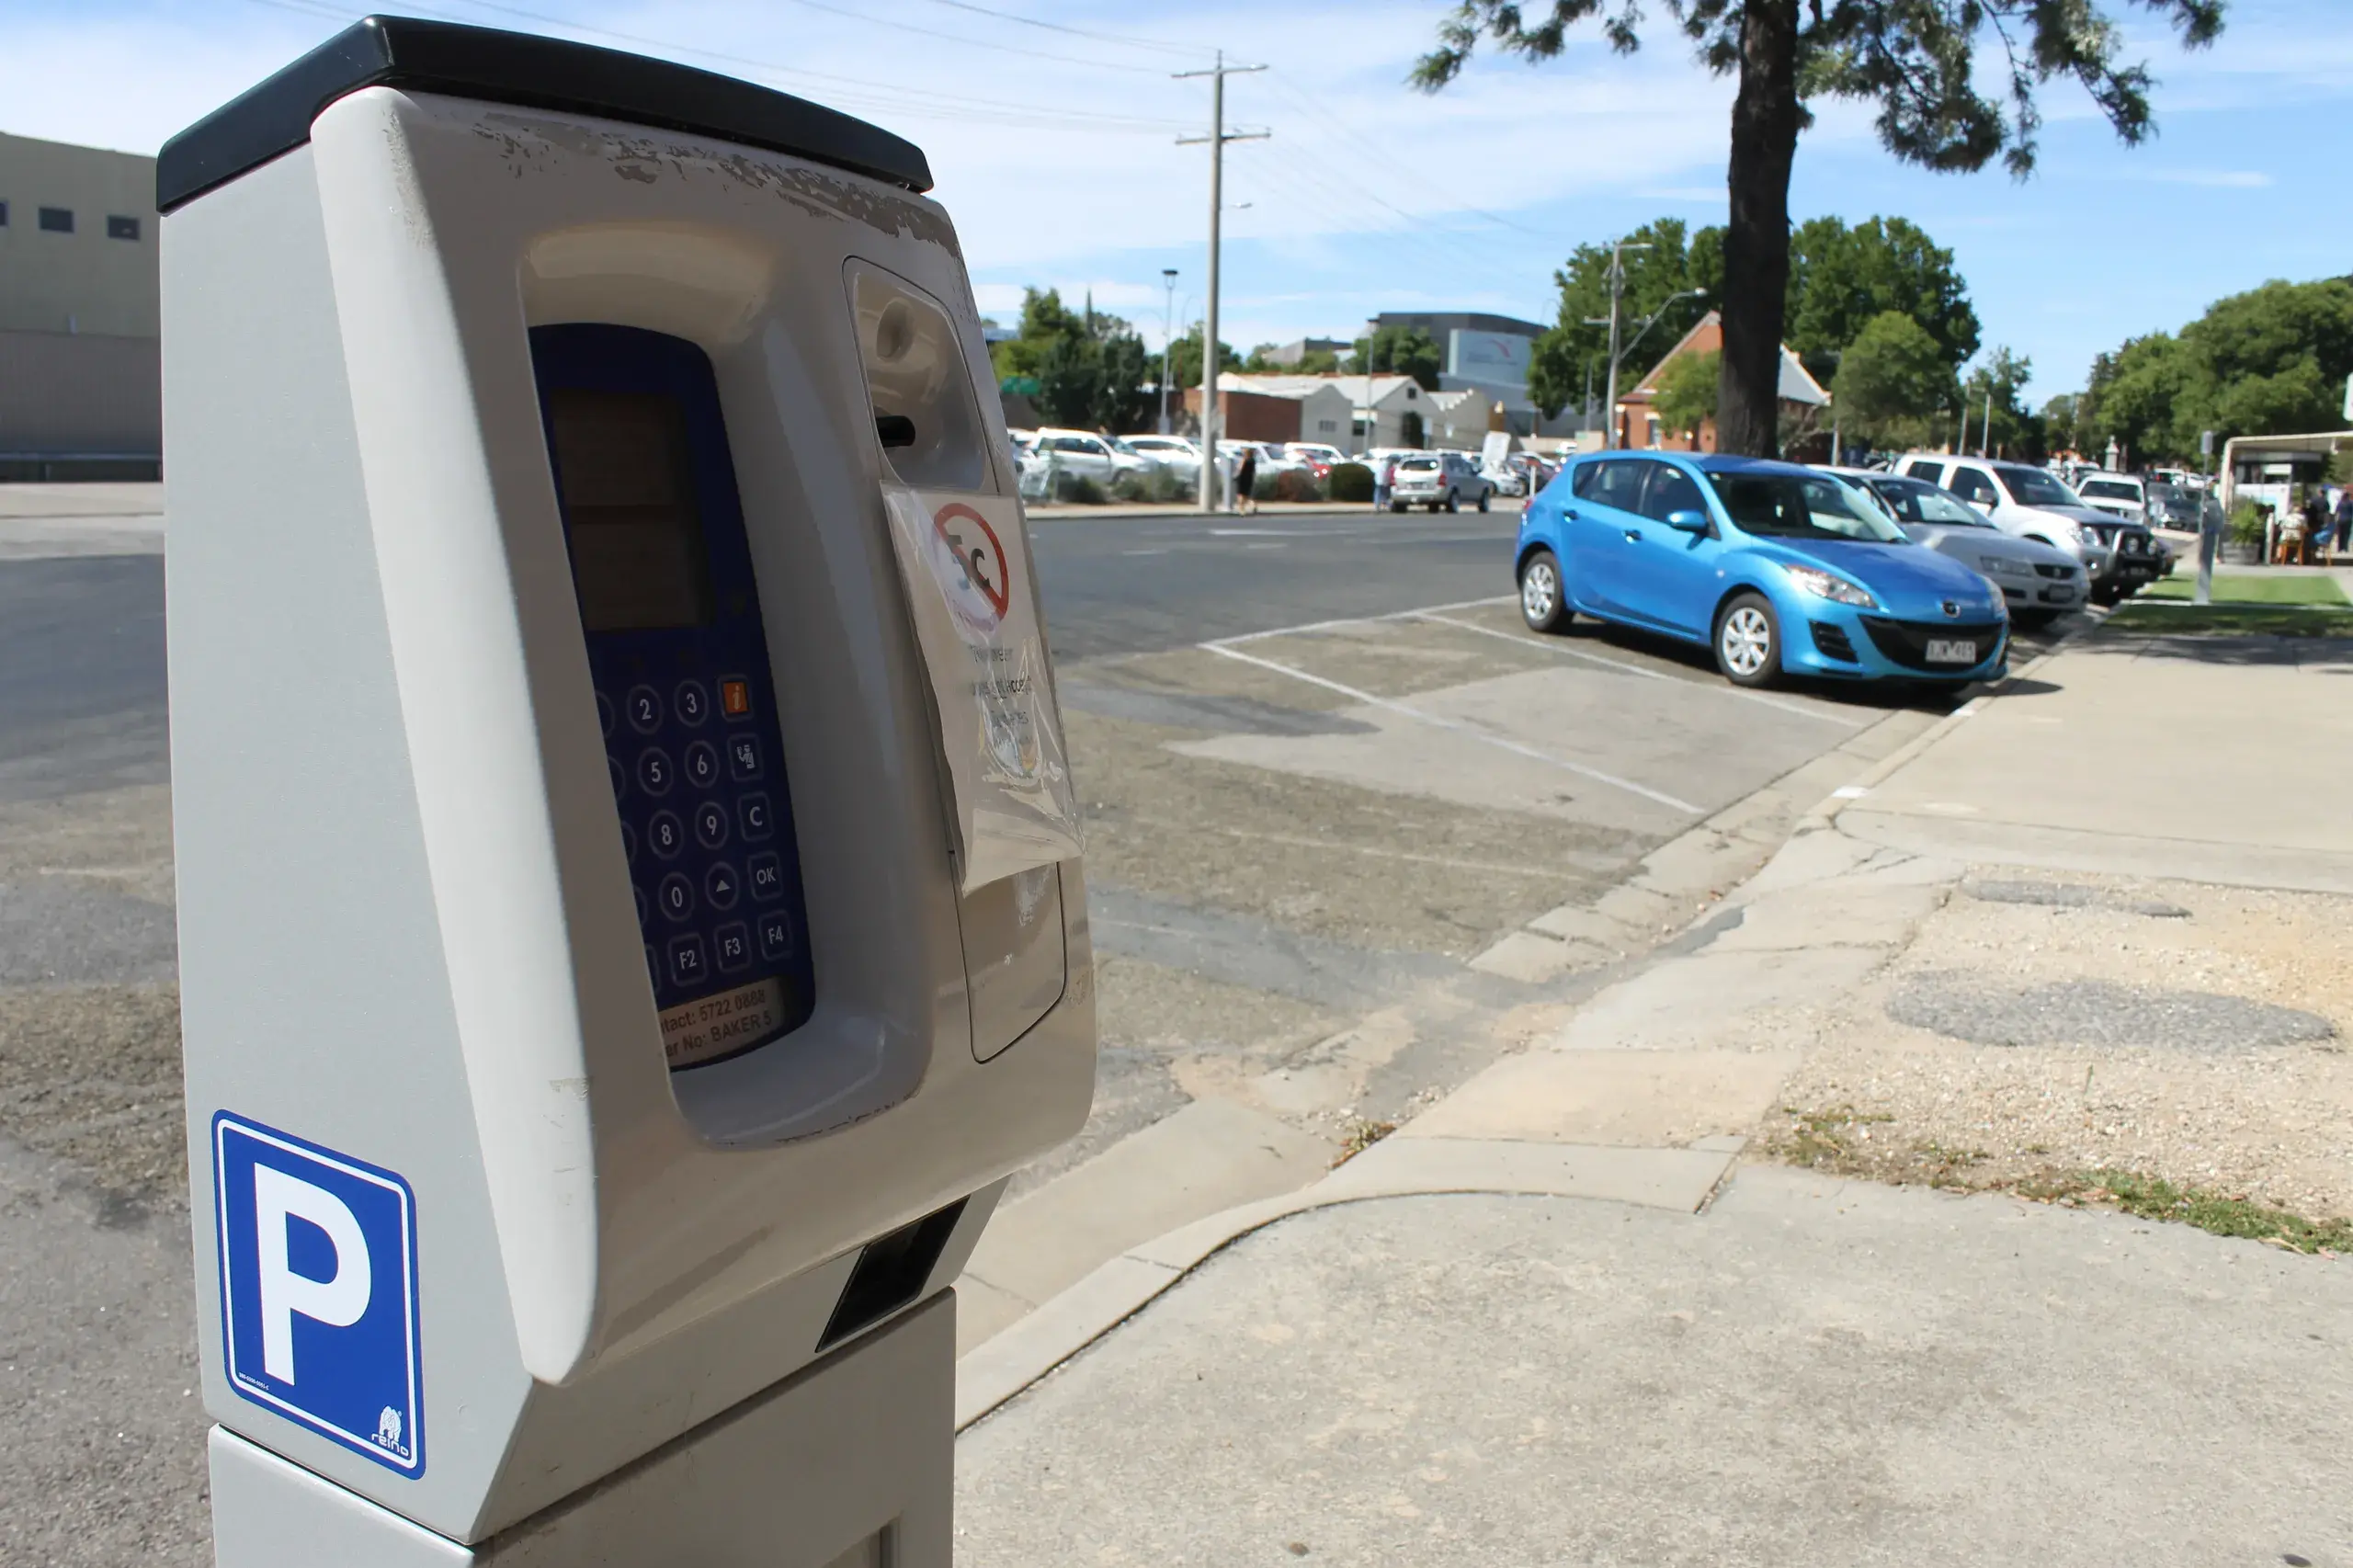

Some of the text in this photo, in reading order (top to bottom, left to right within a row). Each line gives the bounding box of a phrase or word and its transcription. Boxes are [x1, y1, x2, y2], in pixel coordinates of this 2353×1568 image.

[686, 693, 698, 713] 3
[732, 686, 742, 710] i
[639, 699, 652, 720] 2
[650, 762, 662, 782] 5
[697, 755, 708, 775] 6
[706, 815, 717, 835] 9
[749, 806, 763, 826] C
[661, 824, 673, 846] 8
[756, 867, 777, 885] OK
[671, 886, 683, 908] 0
[767, 925, 784, 945] F4
[724, 937, 742, 957] F3
[678, 949, 698, 970] F2
[699, 999, 733, 1022] 5722
[682, 1033, 708, 1052] No:
[710, 1014, 762, 1042] BAKER
[254, 1162, 372, 1387] P
[370, 1432, 410, 1458] reino
